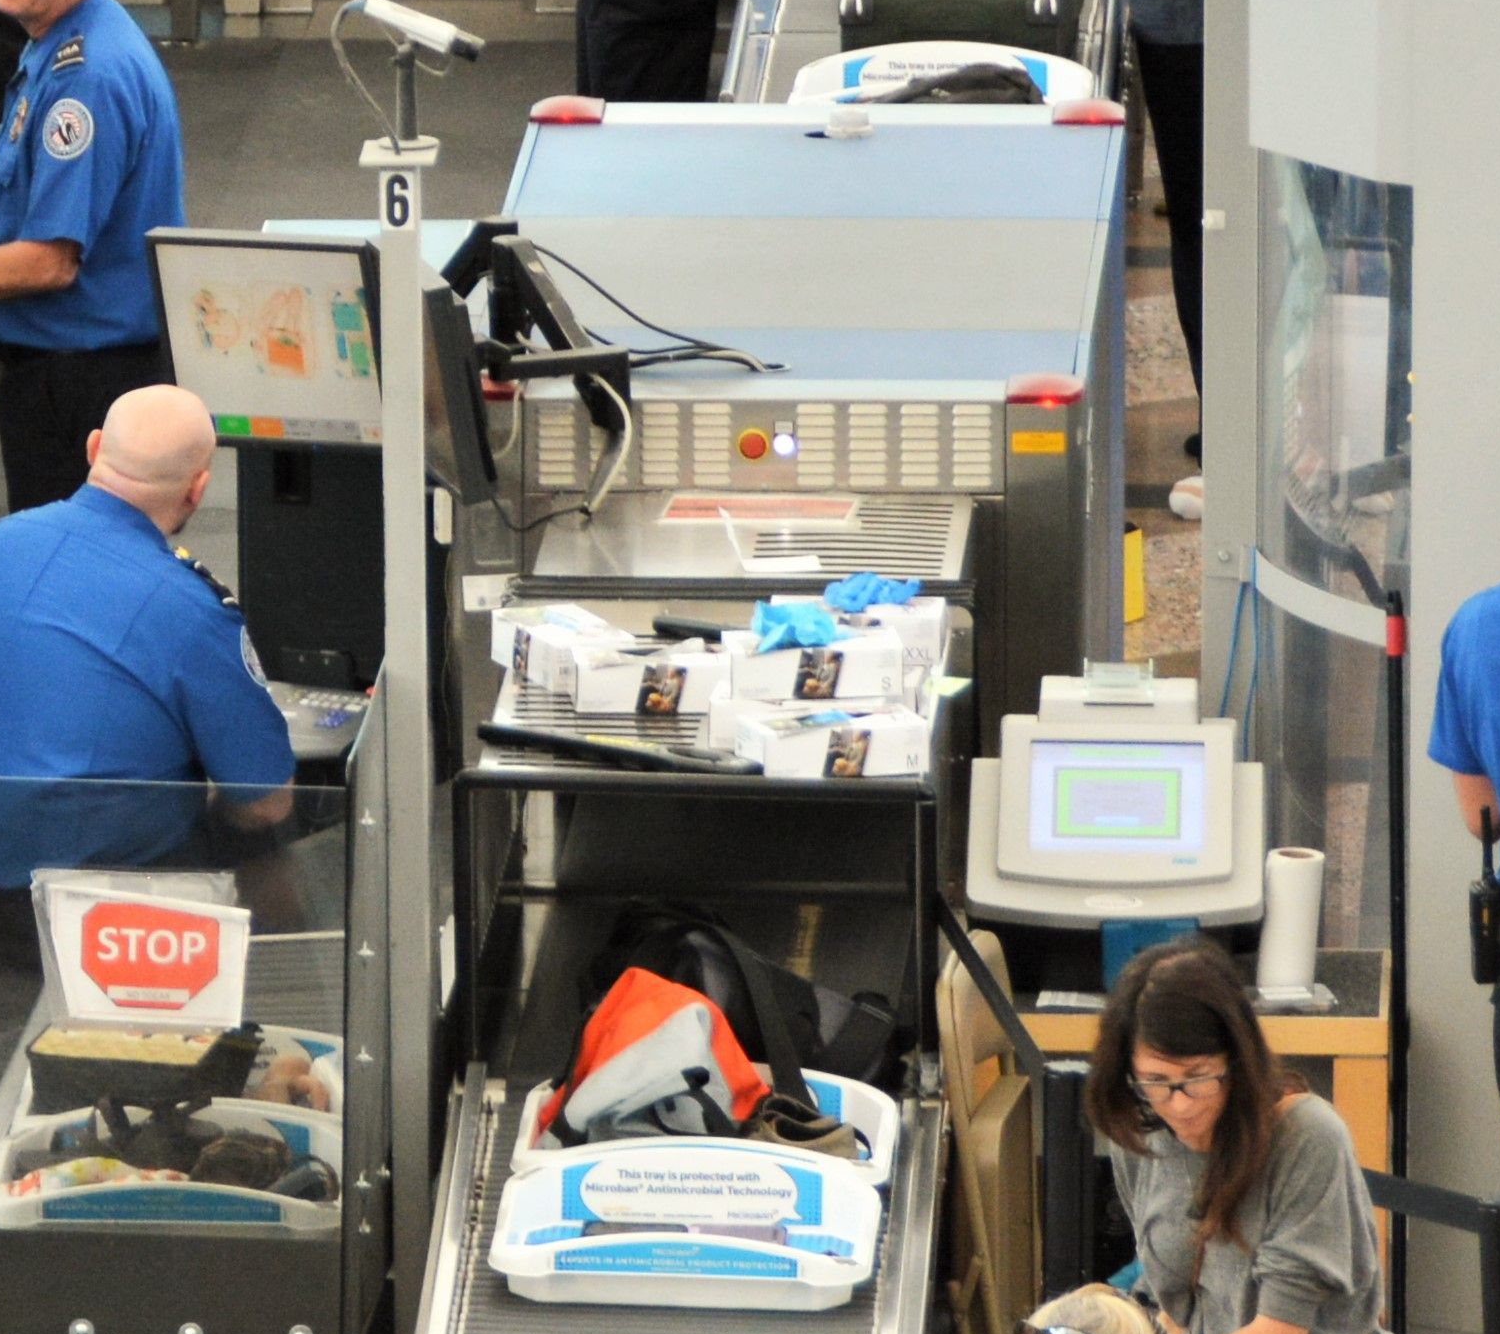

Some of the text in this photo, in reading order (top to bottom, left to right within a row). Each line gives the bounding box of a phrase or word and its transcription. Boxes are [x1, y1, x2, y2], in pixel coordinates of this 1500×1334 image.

[57, 43, 81, 60] TSA
[386, 174, 410, 228] 6
[905, 646, 934, 661] XXL
[881, 675, 892, 690] S
[906, 753, 919, 766] M
[96, 926, 207, 965] STOP
[617, 1168, 761, 1183] This tray is protected with
[646, 1183, 724, 1196] Antimicrobial
[727, 1185, 792, 1199] Technology
